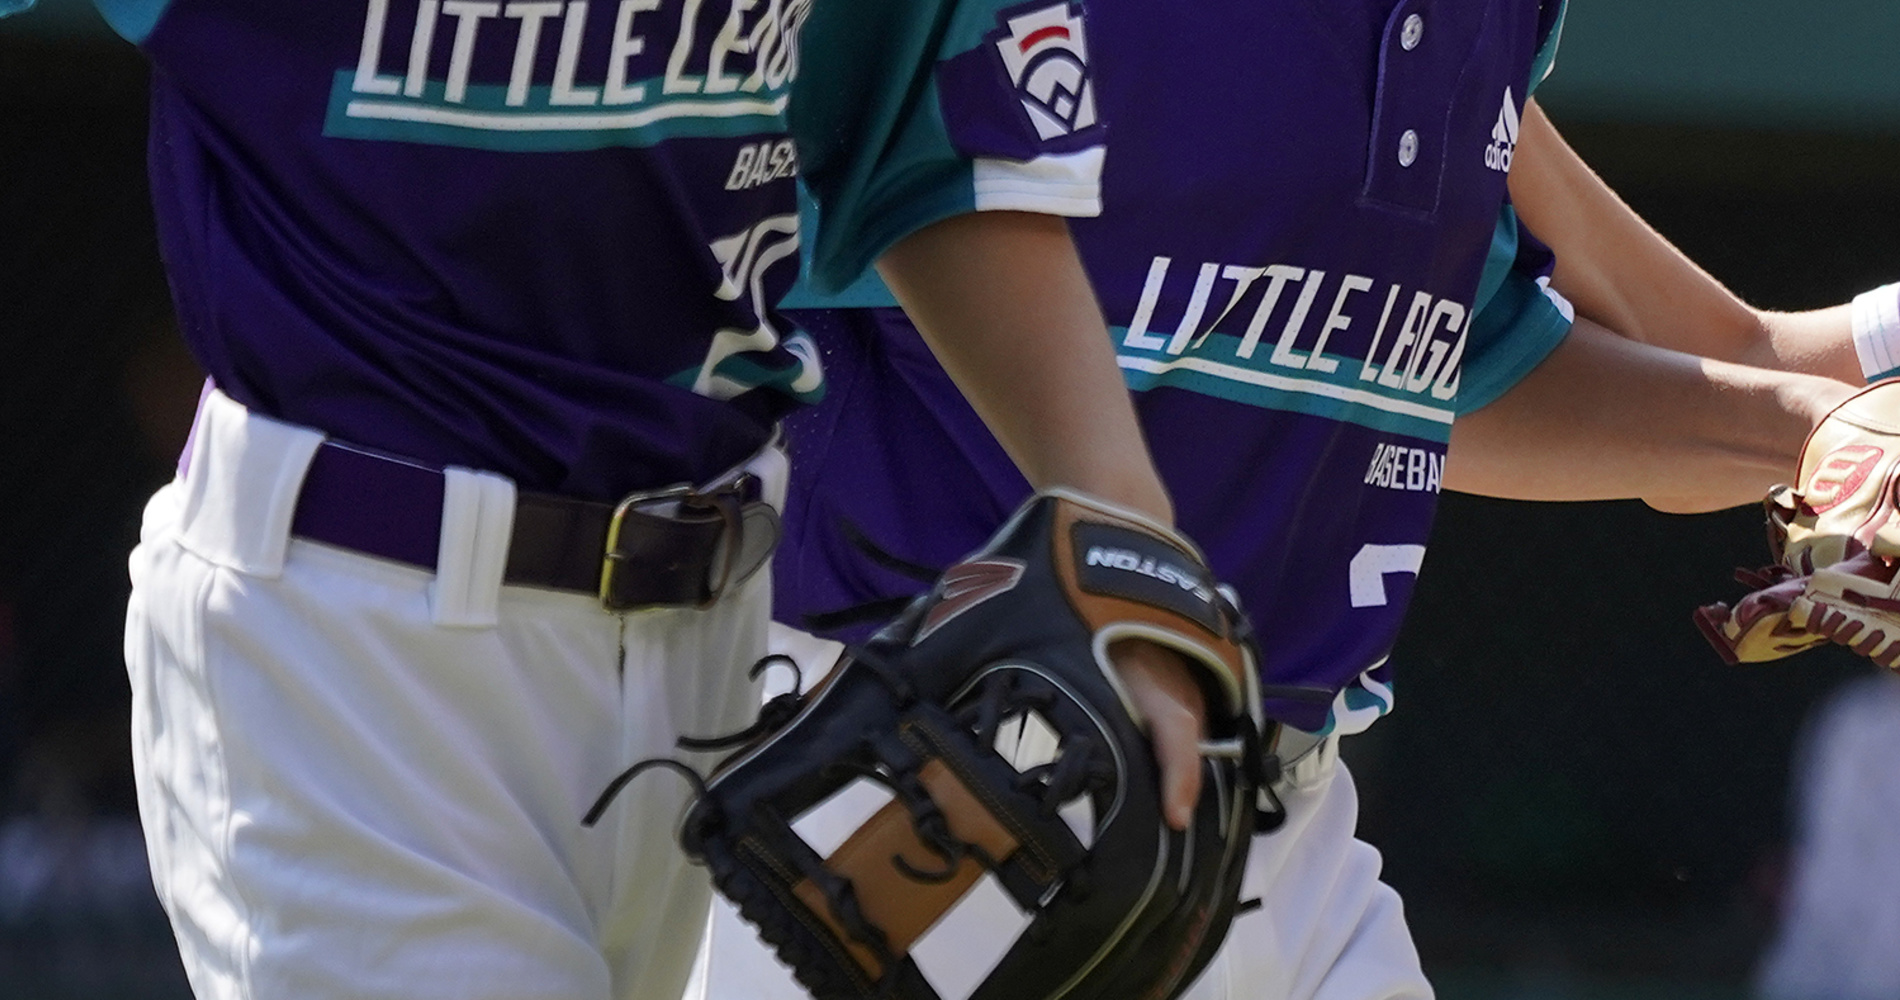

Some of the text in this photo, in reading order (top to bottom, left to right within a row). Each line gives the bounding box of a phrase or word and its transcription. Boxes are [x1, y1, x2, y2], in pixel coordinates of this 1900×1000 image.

[1485, 140, 1514, 174] adid
[1123, 256, 1375, 374] LITTLE
[1364, 442, 1446, 496] BASEBA
